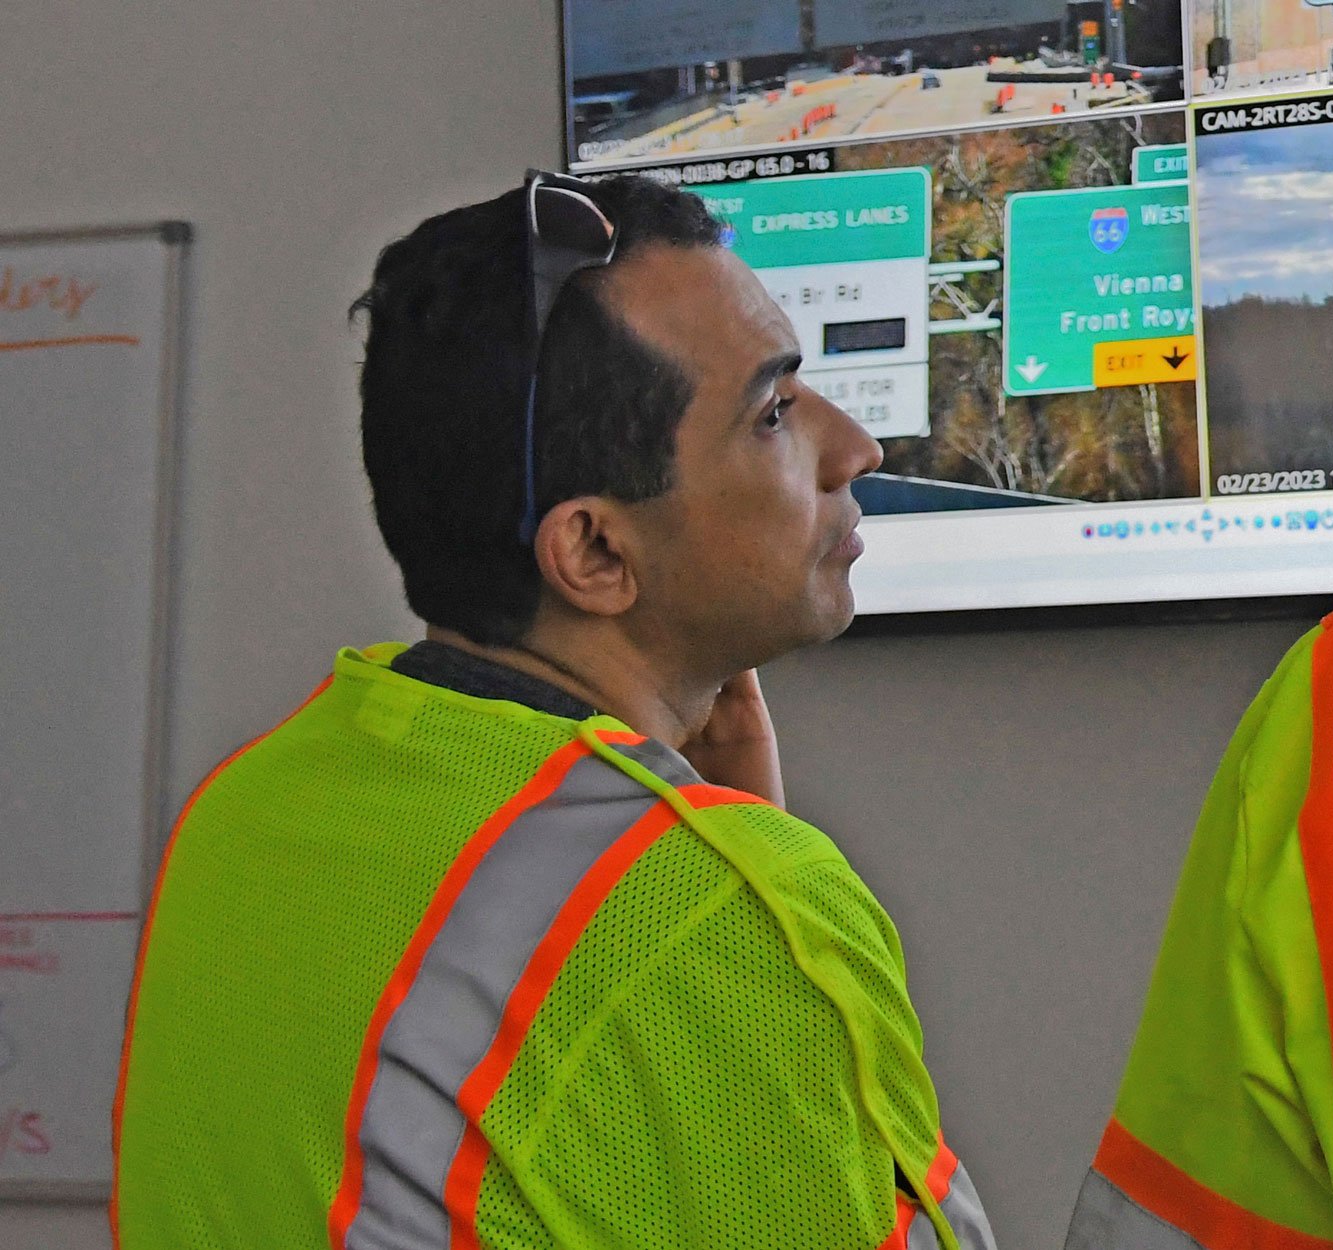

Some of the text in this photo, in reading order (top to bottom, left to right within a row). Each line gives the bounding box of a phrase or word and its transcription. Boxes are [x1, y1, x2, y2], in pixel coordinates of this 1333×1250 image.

[807, 151, 829, 171] 16
[752, 205, 909, 234] EXPRESS LANES
[1093, 222, 1122, 242] 66
[1093, 273, 1184, 297] Vienna
[1060, 308, 1131, 334] Front
[1108, 353, 1146, 371] EXIT
[1217, 468, 1326, 495] 02/23/2023
